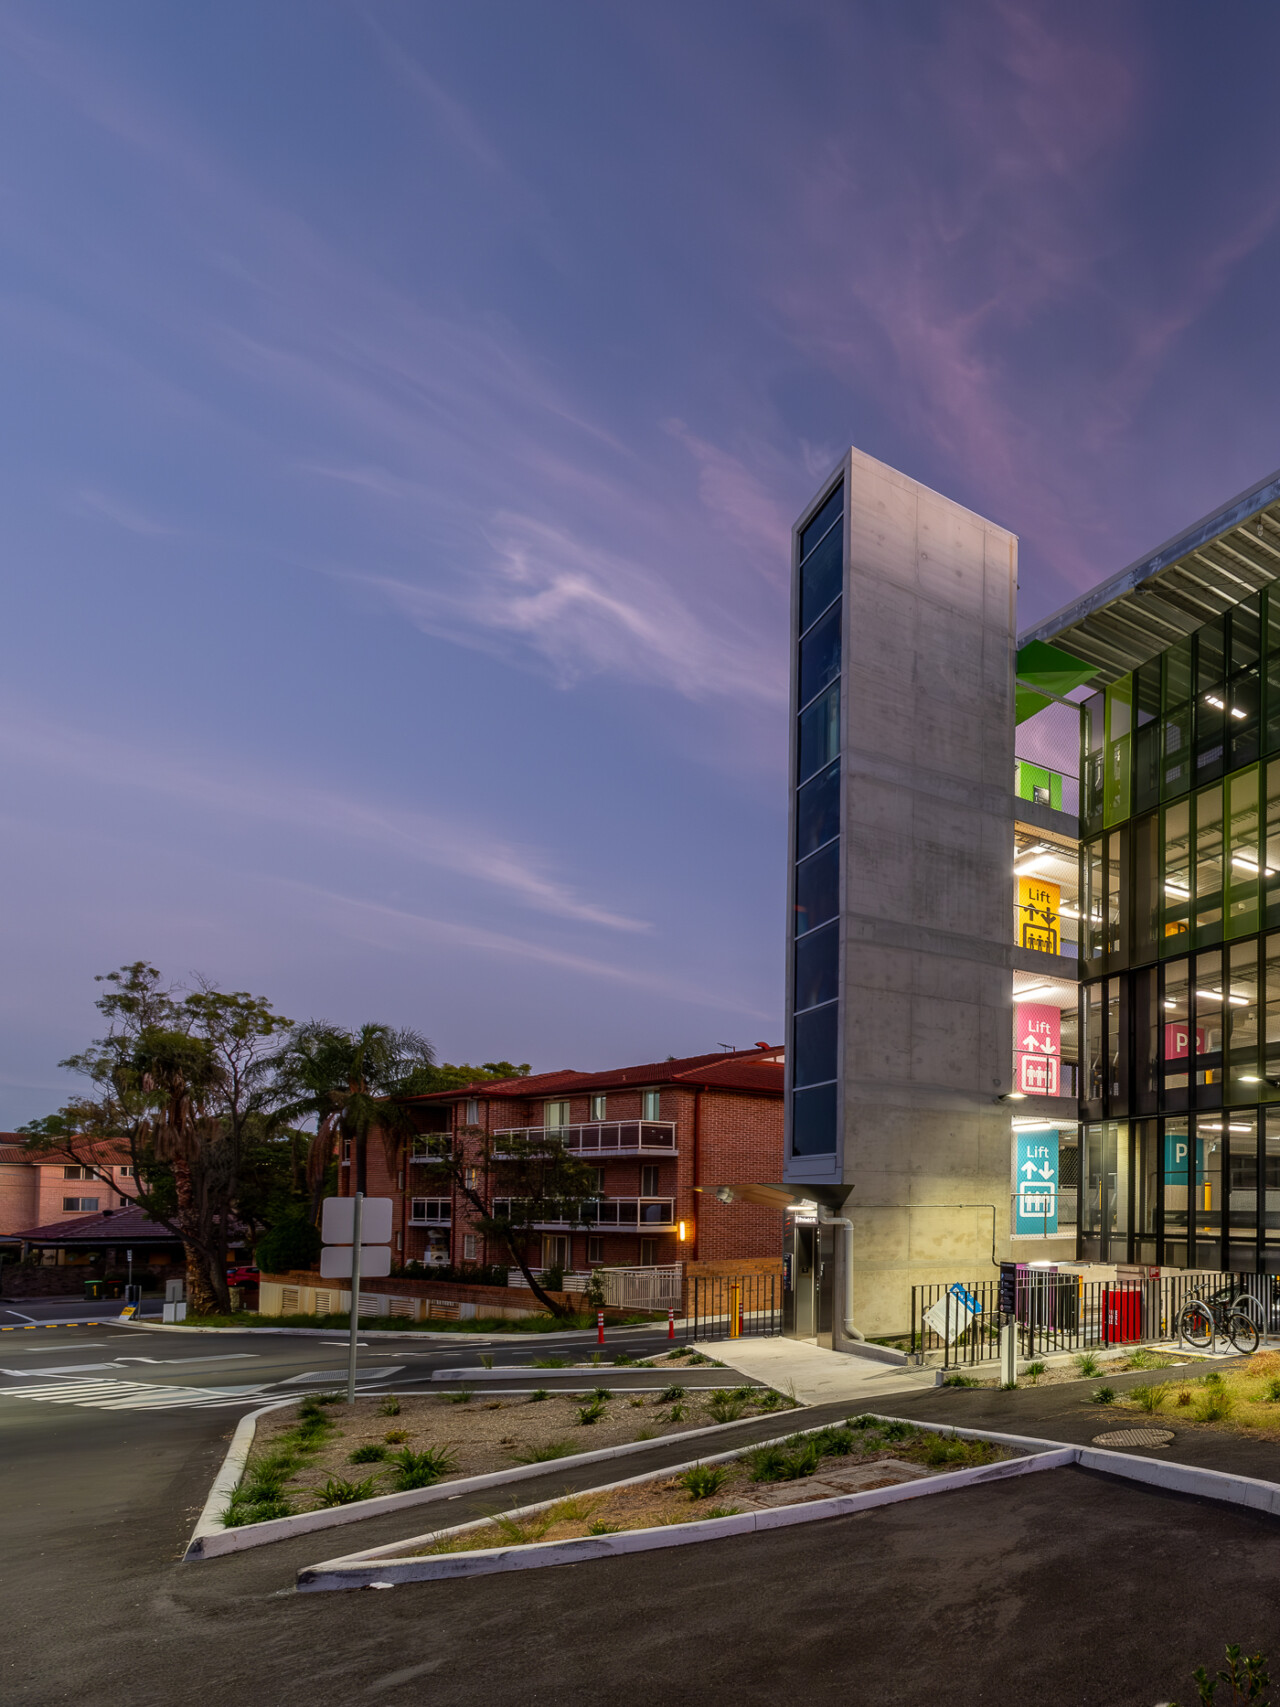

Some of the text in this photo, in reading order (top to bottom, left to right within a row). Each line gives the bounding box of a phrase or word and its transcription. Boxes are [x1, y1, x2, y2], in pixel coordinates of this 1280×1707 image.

[1028, 887, 1051, 904] Lift
[1028, 1019, 1051, 1035] Lift
[1026, 1145, 1049, 1159] Lift
